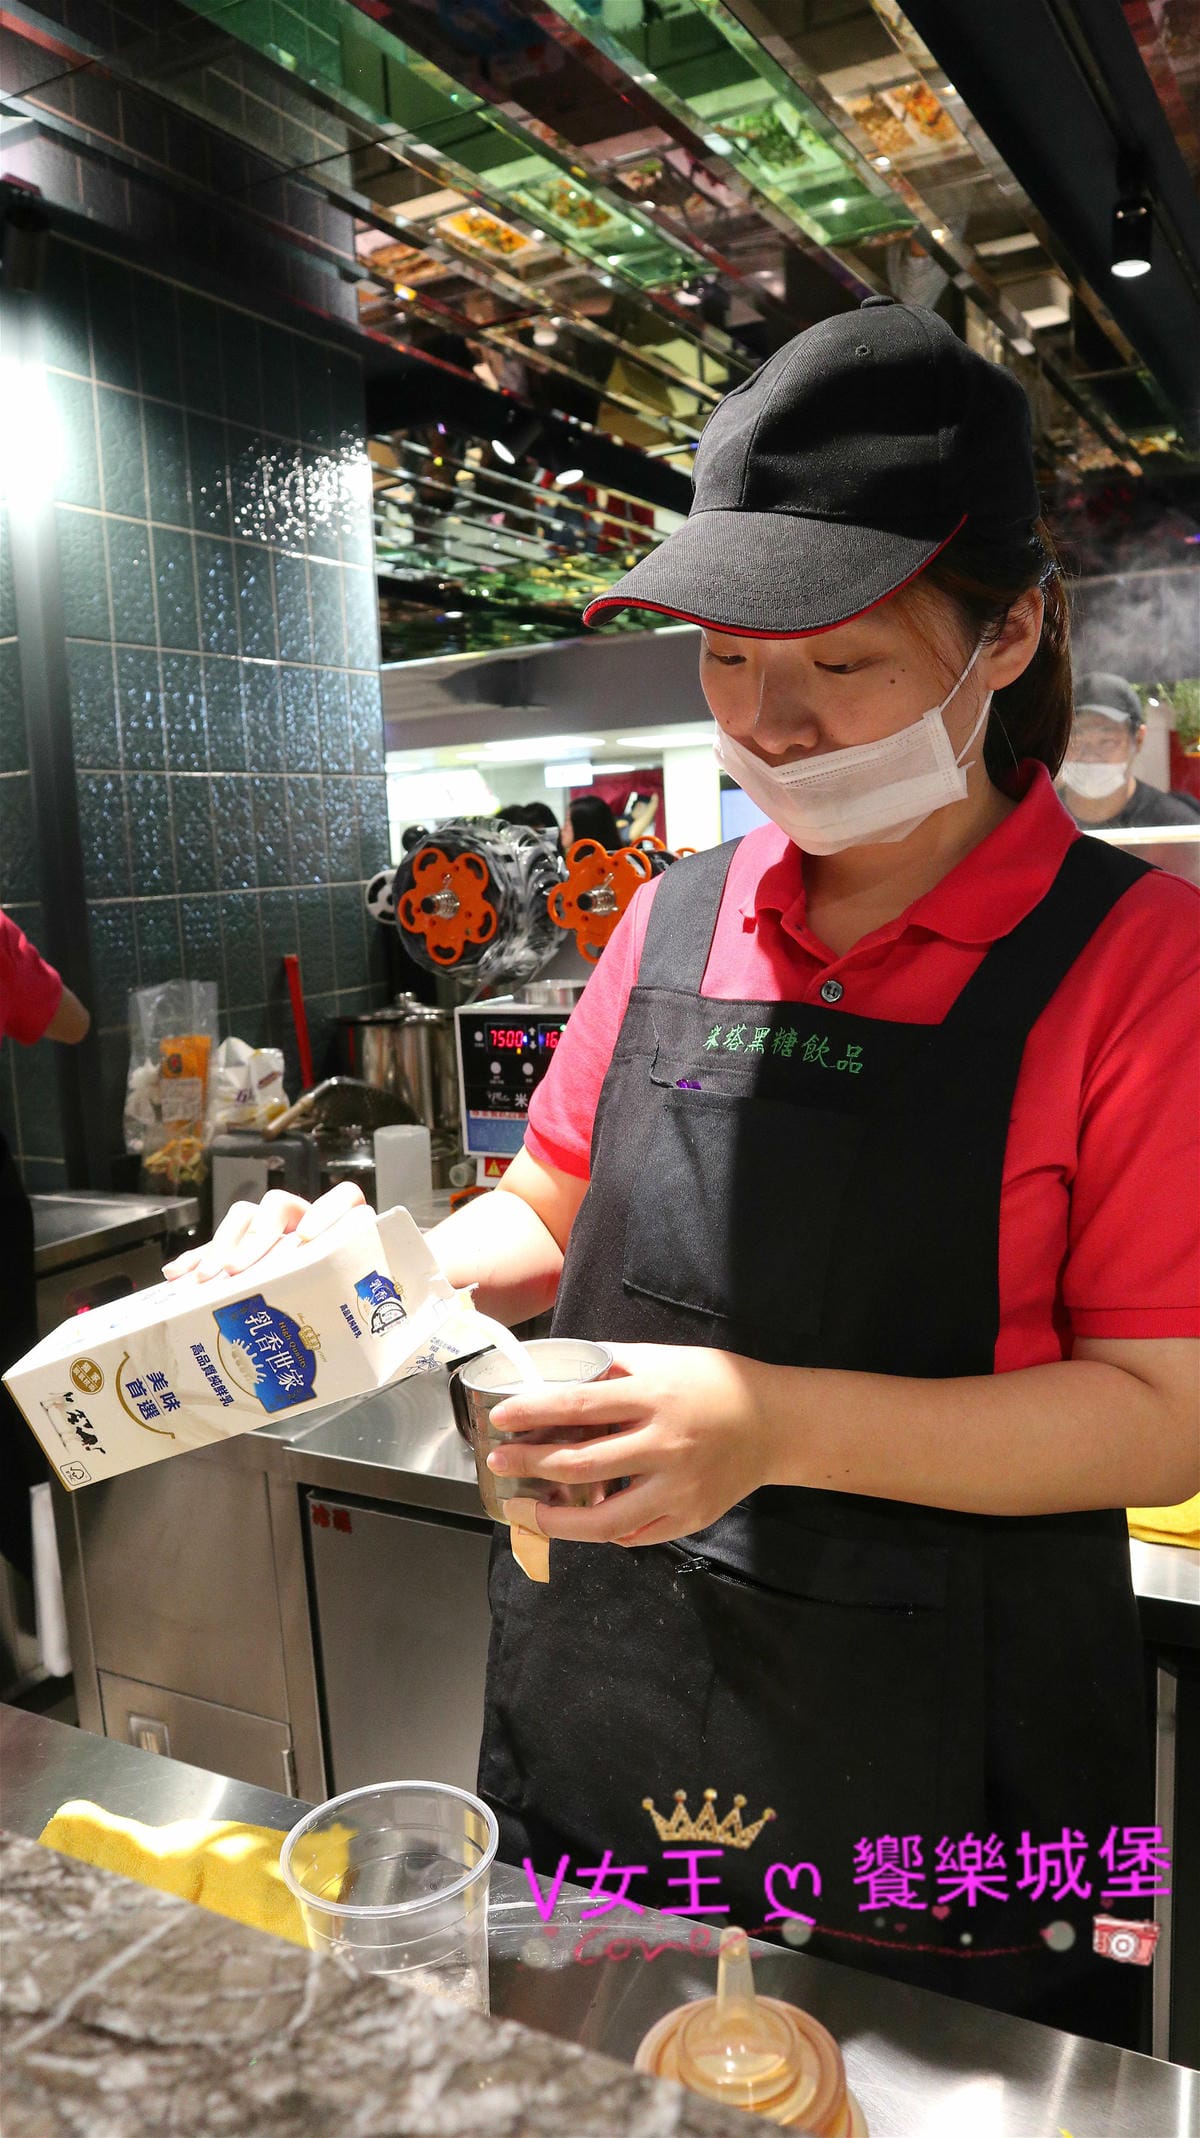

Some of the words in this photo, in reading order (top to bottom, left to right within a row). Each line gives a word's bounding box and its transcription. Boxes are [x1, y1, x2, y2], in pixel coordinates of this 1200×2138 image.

[490, 1030, 524, 1048] 7500
[245, 1311, 304, 1391] 乳香世家
[145, 1371, 181, 1412] 美味
[190, 1342, 234, 1407] 高品質純鮮乳
[125, 1378, 161, 1420] 首選
